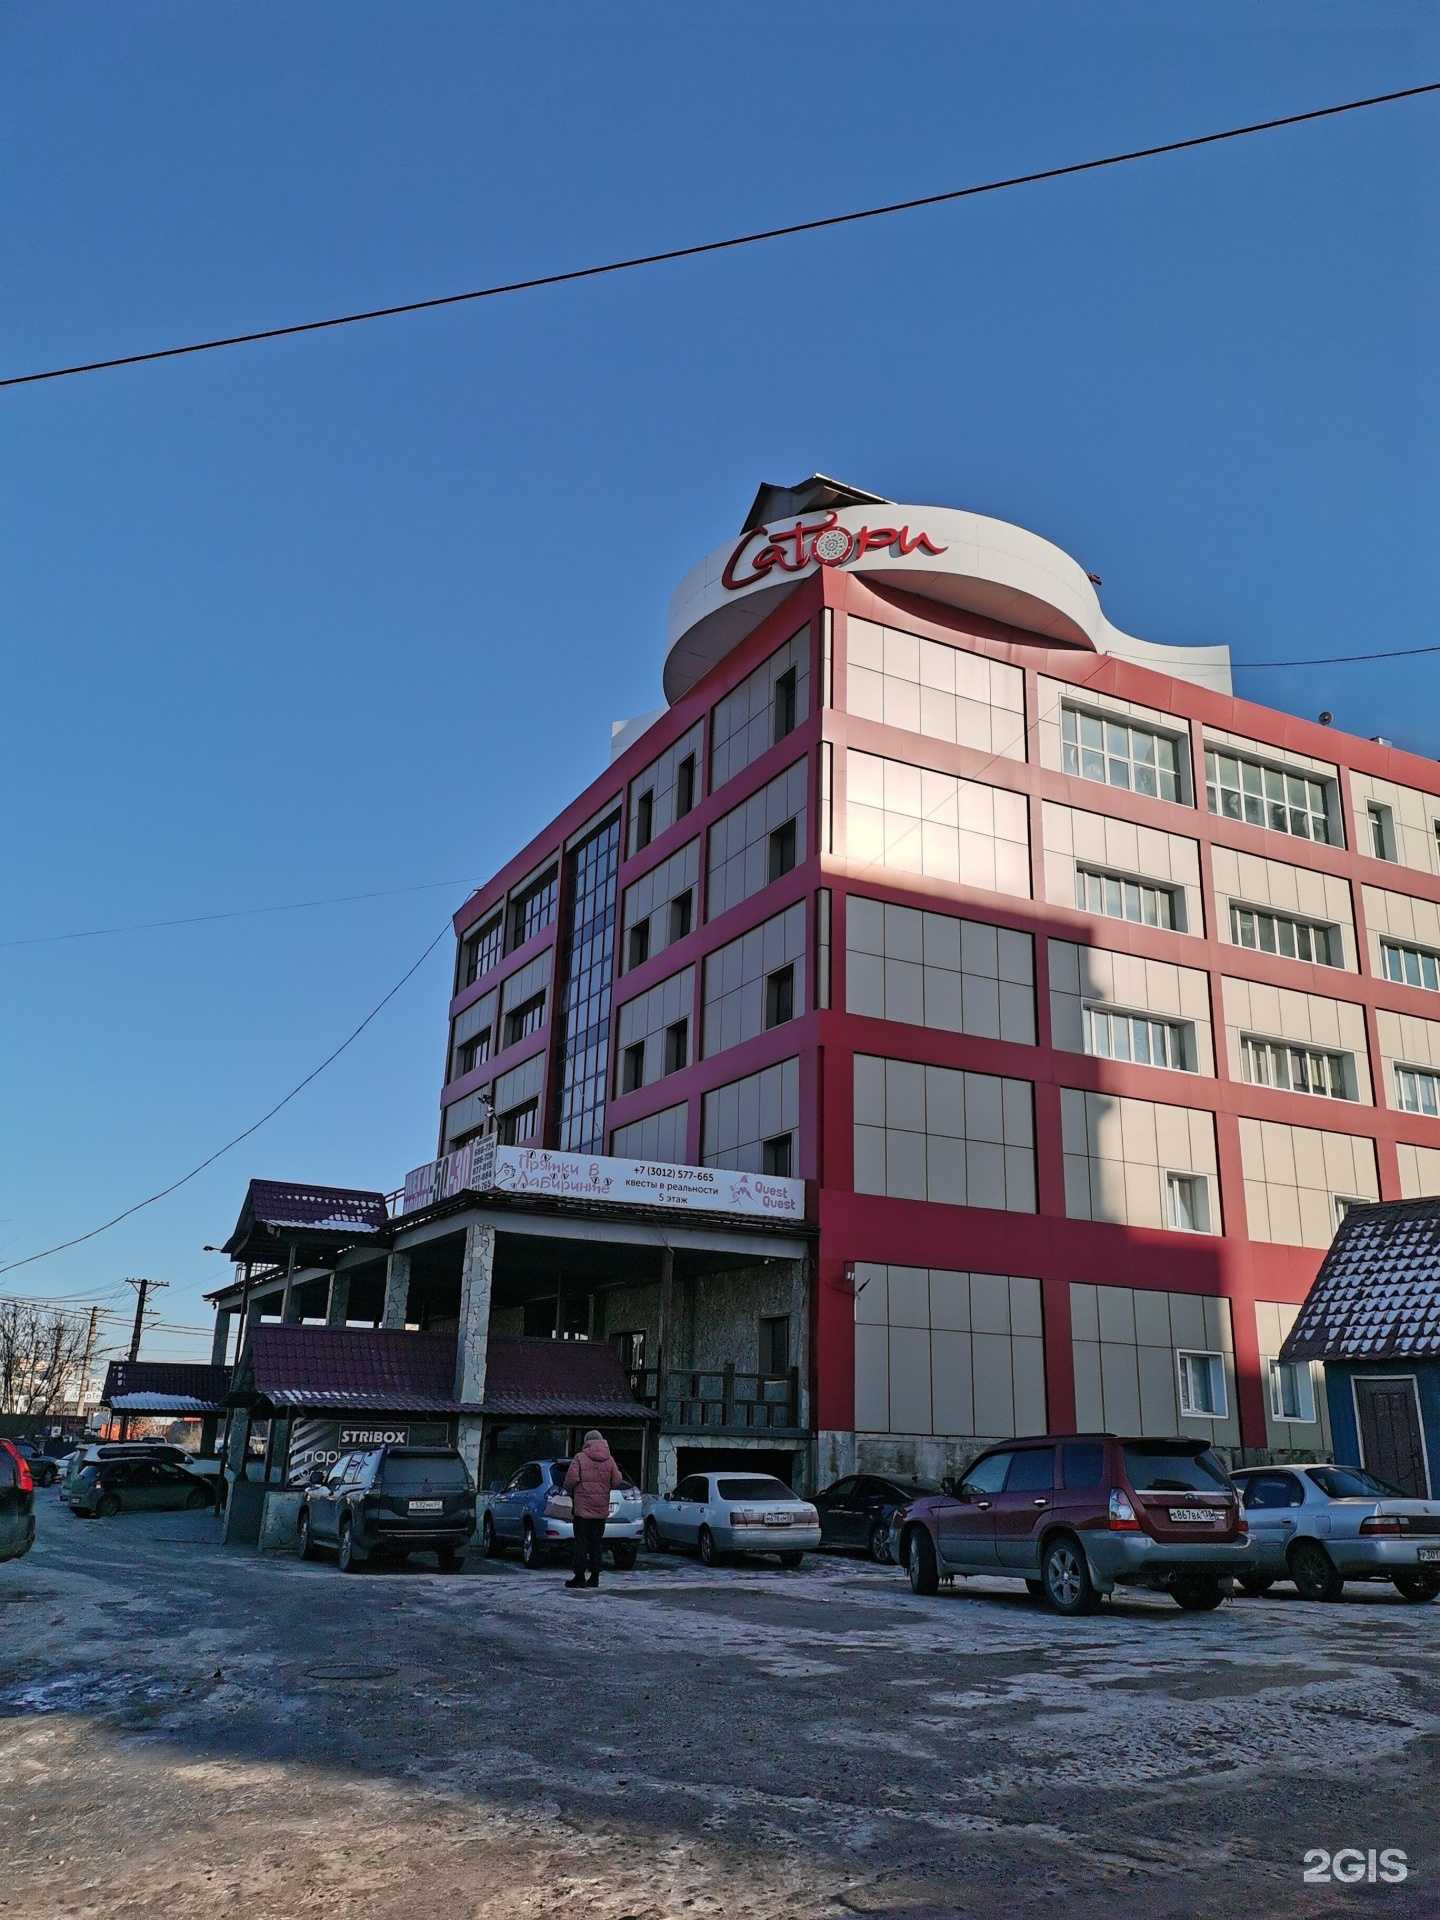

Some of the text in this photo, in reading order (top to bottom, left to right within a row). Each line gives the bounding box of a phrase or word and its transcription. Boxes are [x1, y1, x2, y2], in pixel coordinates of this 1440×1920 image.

[518, 1151, 579, 1175] Прятки
[632, 1165, 714, 1182] +7 (3012) 577-665
[625, 1179, 719, 1195] квесты в реальности
[755, 1181, 788, 1199] Quest
[658, 1192, 688, 1205] 5 этаж
[762, 1195, 796, 1210] Quest
